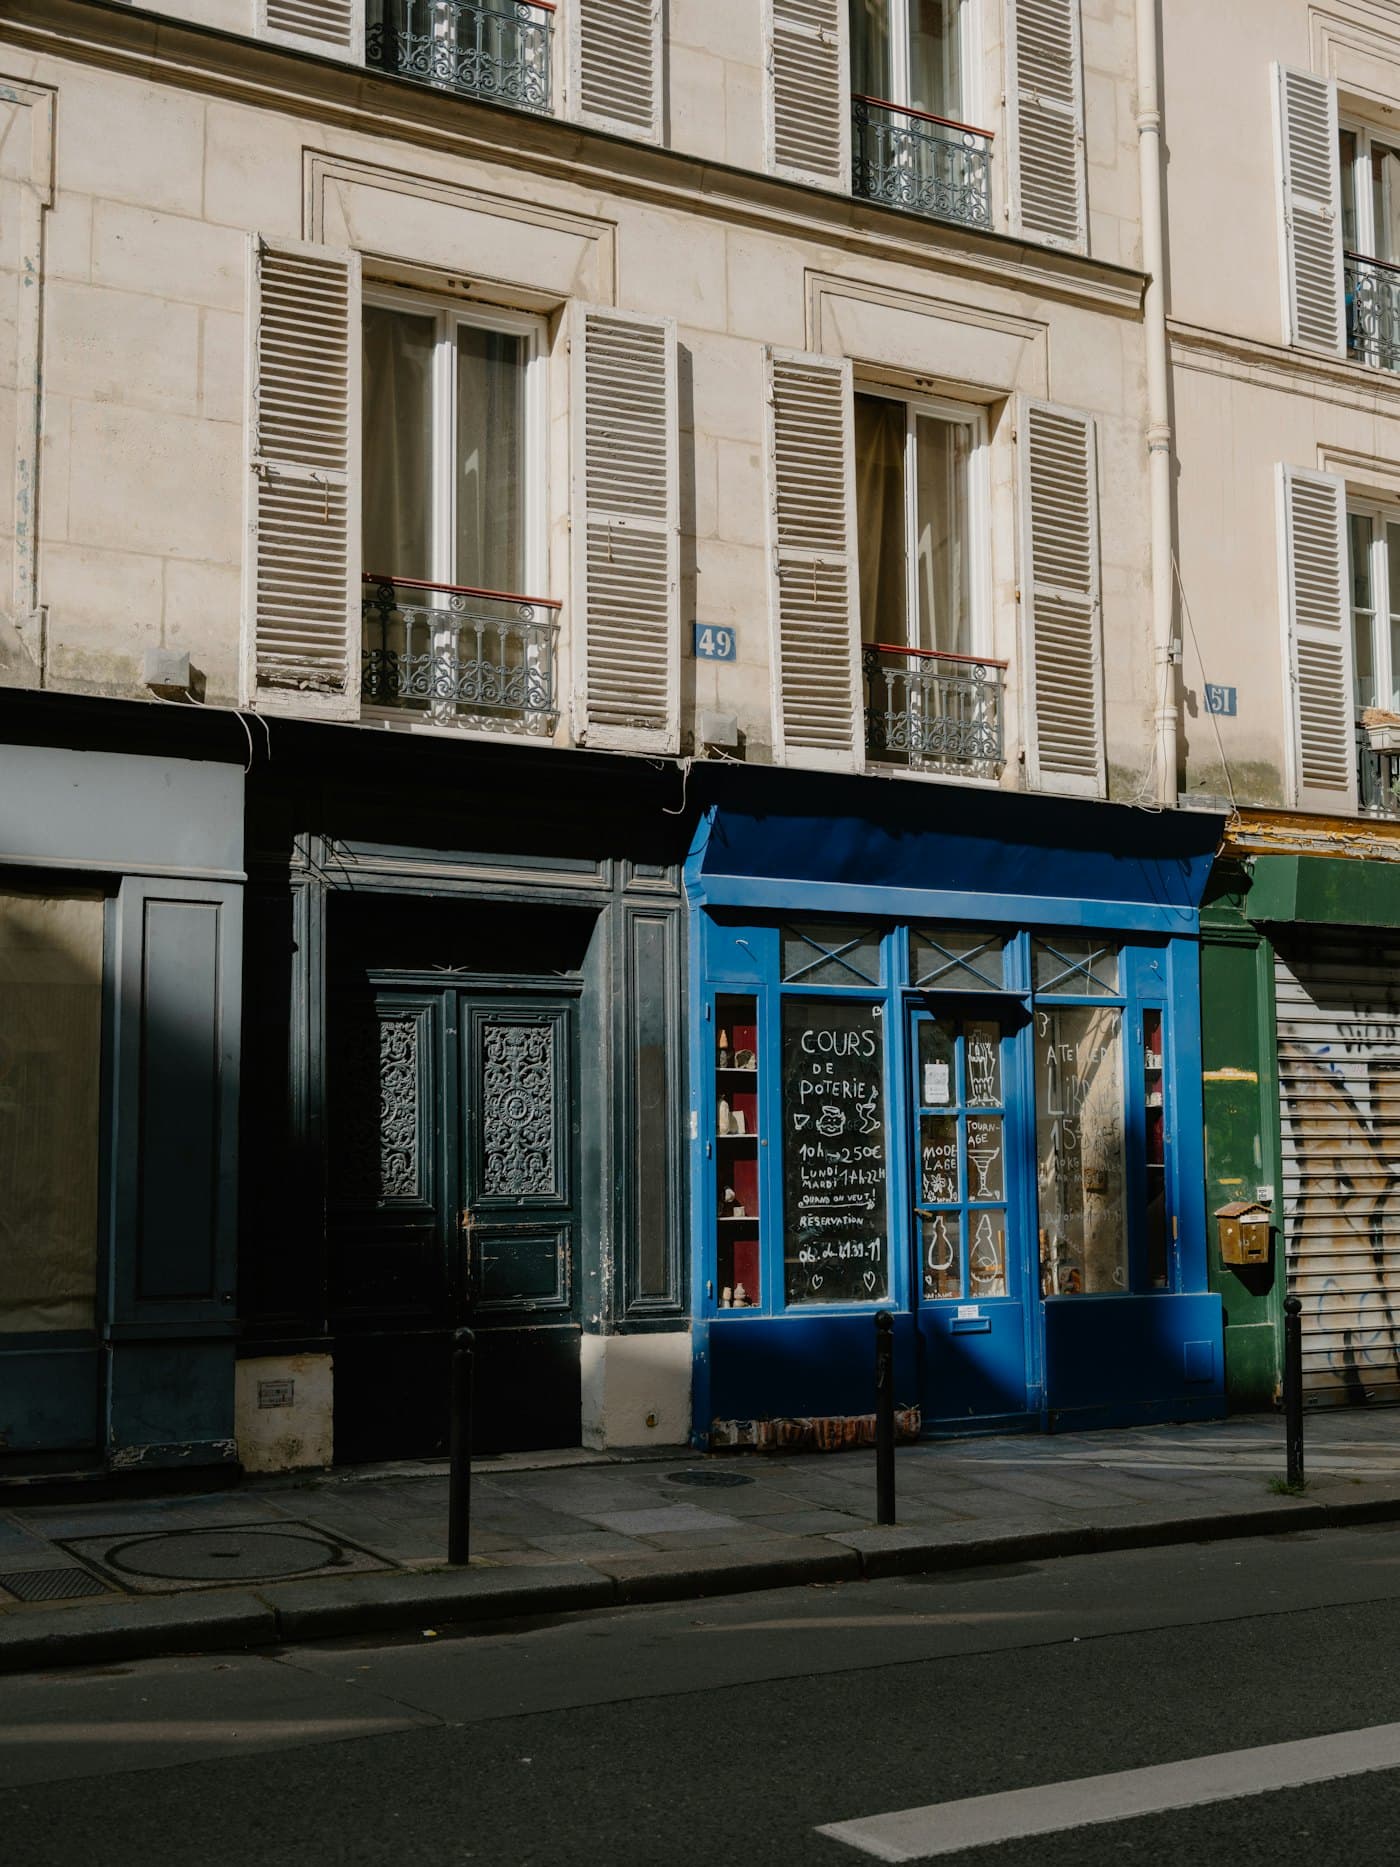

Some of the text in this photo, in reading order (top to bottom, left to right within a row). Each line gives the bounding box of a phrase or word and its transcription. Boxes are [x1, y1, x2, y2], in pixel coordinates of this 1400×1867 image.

[699, 628, 731, 657] 49
[1211, 687, 1230, 713] 51
[801, 1030, 876, 1057] COURS
[812, 1062, 834, 1075] DE
[967, 1133, 989, 1148] AGE
[922, 1144, 958, 1161] MODE
[924, 1159, 958, 1171] LAGE
